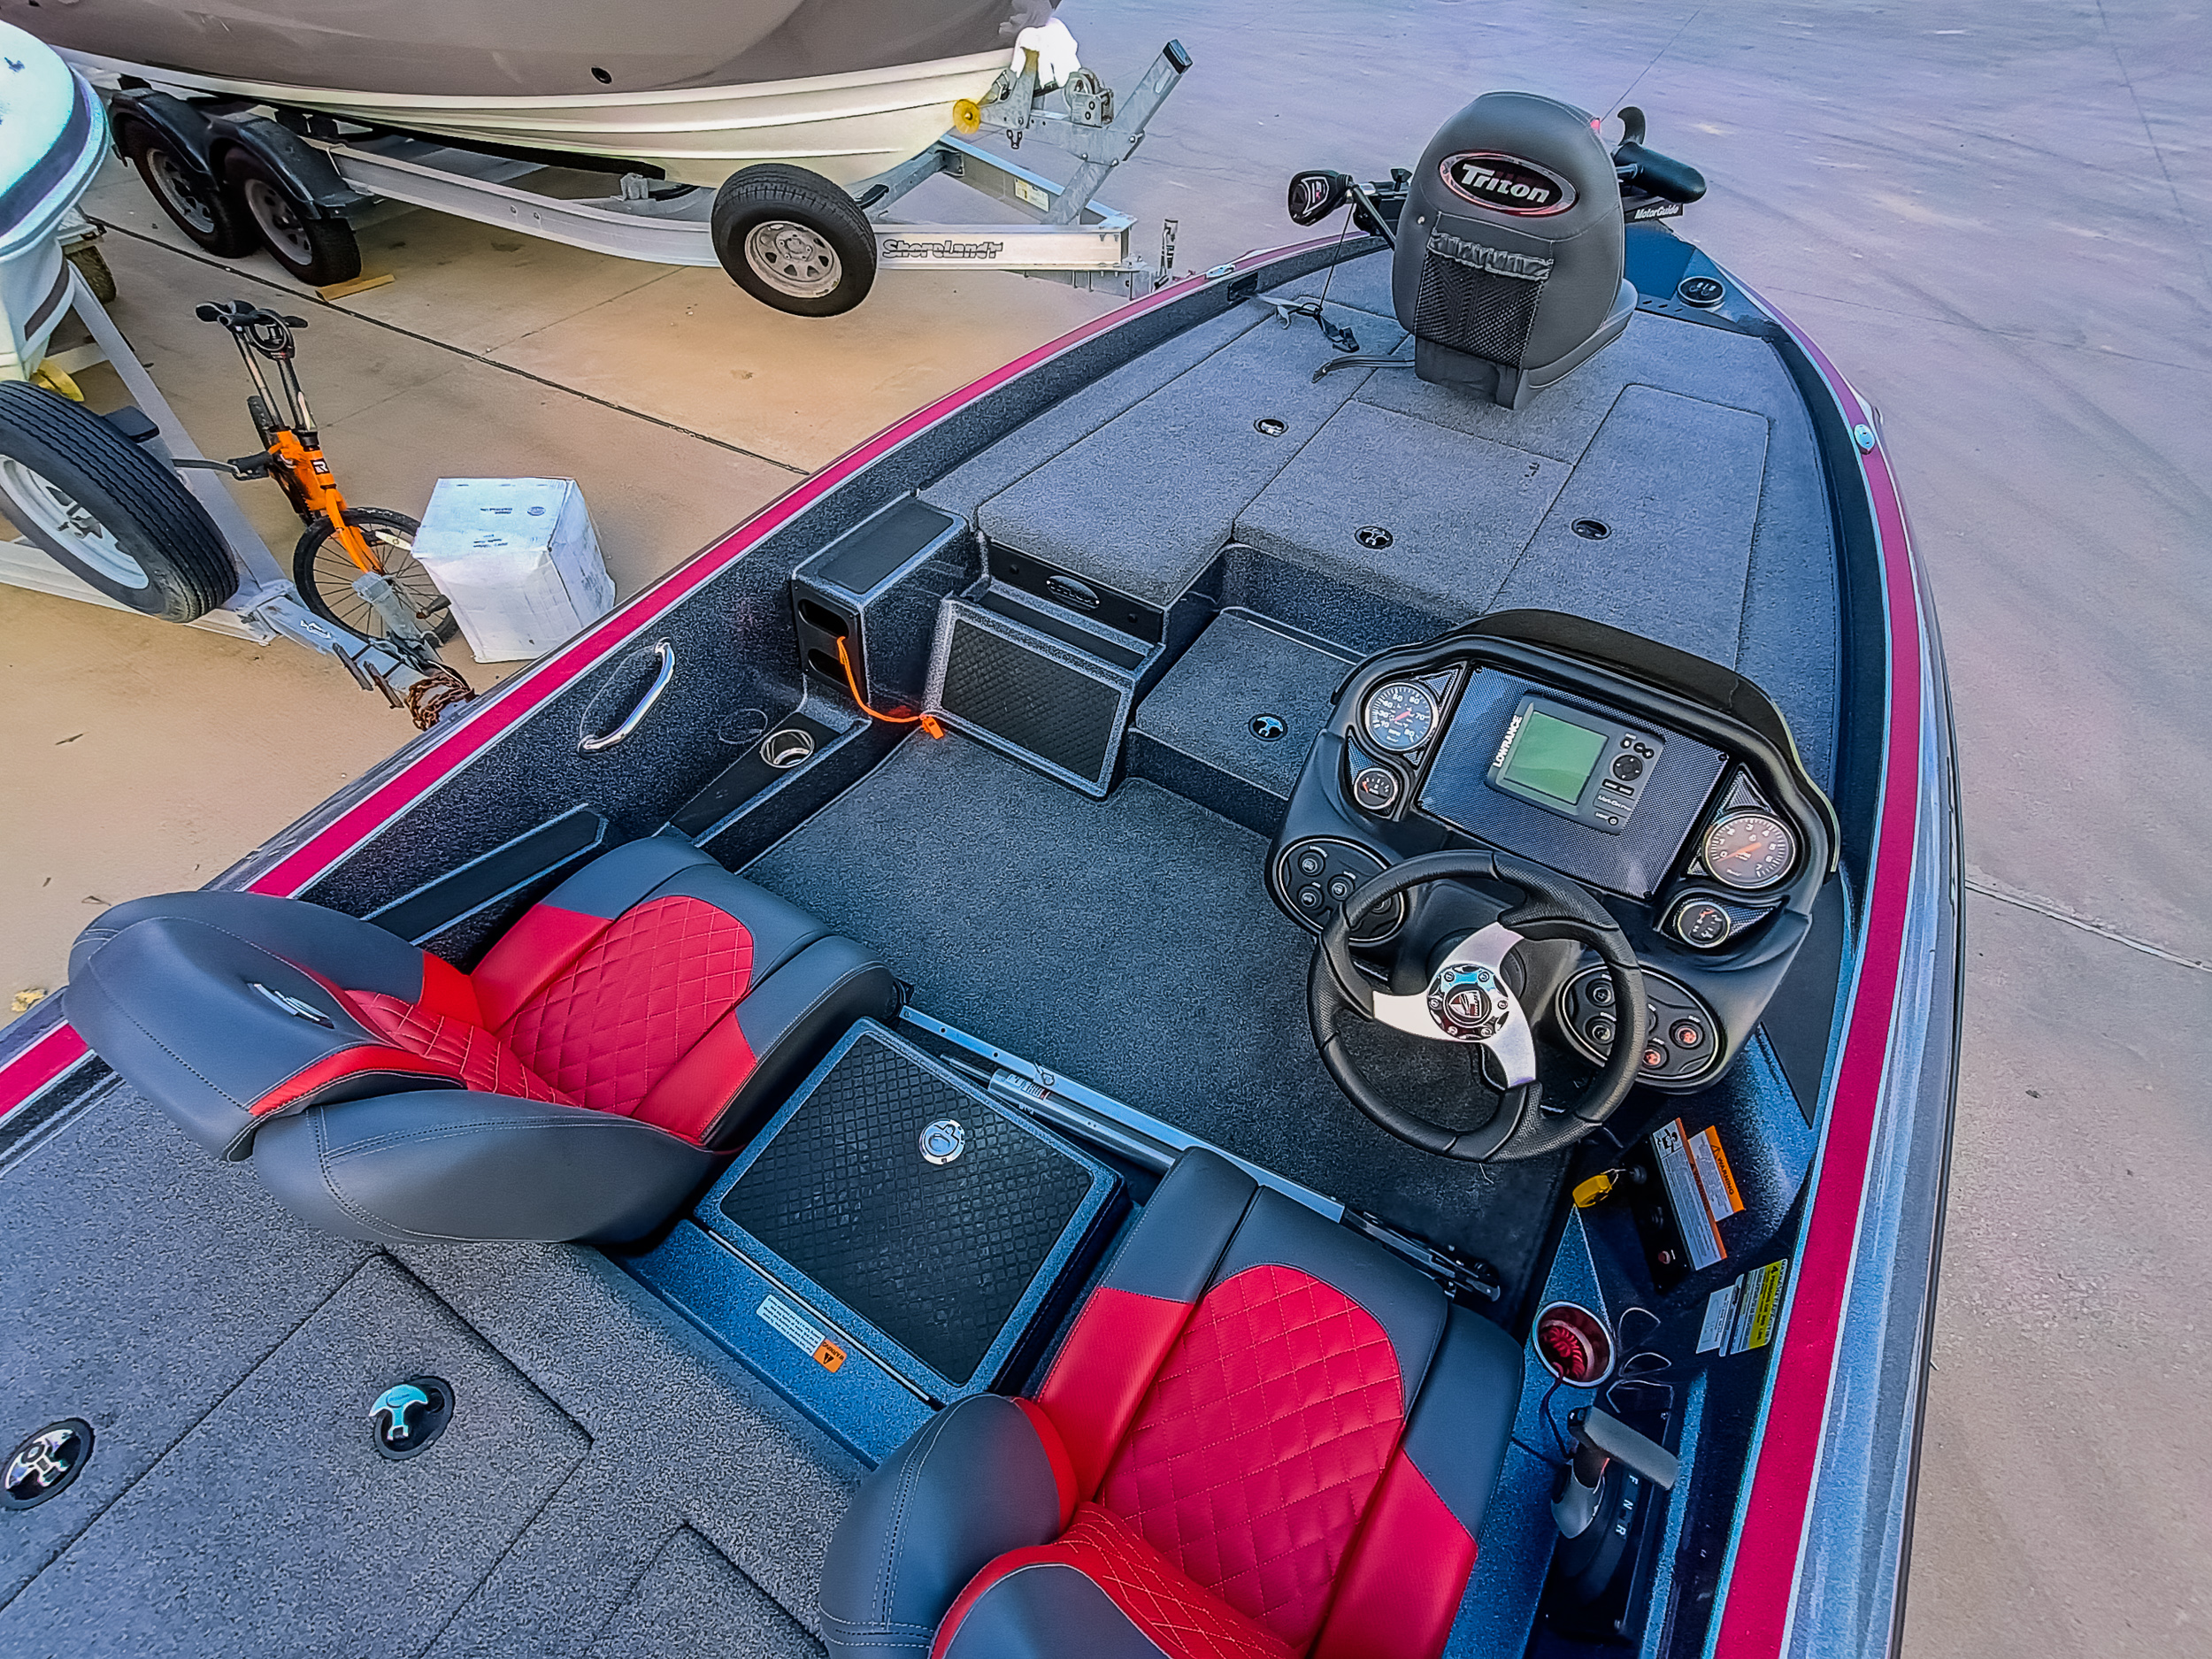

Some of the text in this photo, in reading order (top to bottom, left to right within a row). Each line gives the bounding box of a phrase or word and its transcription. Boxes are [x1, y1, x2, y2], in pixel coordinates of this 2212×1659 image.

[1461, 164, 1550, 204] Triton
[1634, 204, 1679, 219] MotorGuide
[1492, 714, 1523, 768] LOWRANCE
[1715, 1156, 1736, 1195] WARNING
[1690, 1171, 1712, 1211] WARNING
[822, 1341, 844, 1361] WARNING
[1623, 1499, 1633, 1509] N
[1616, 1525, 1626, 1535] R
